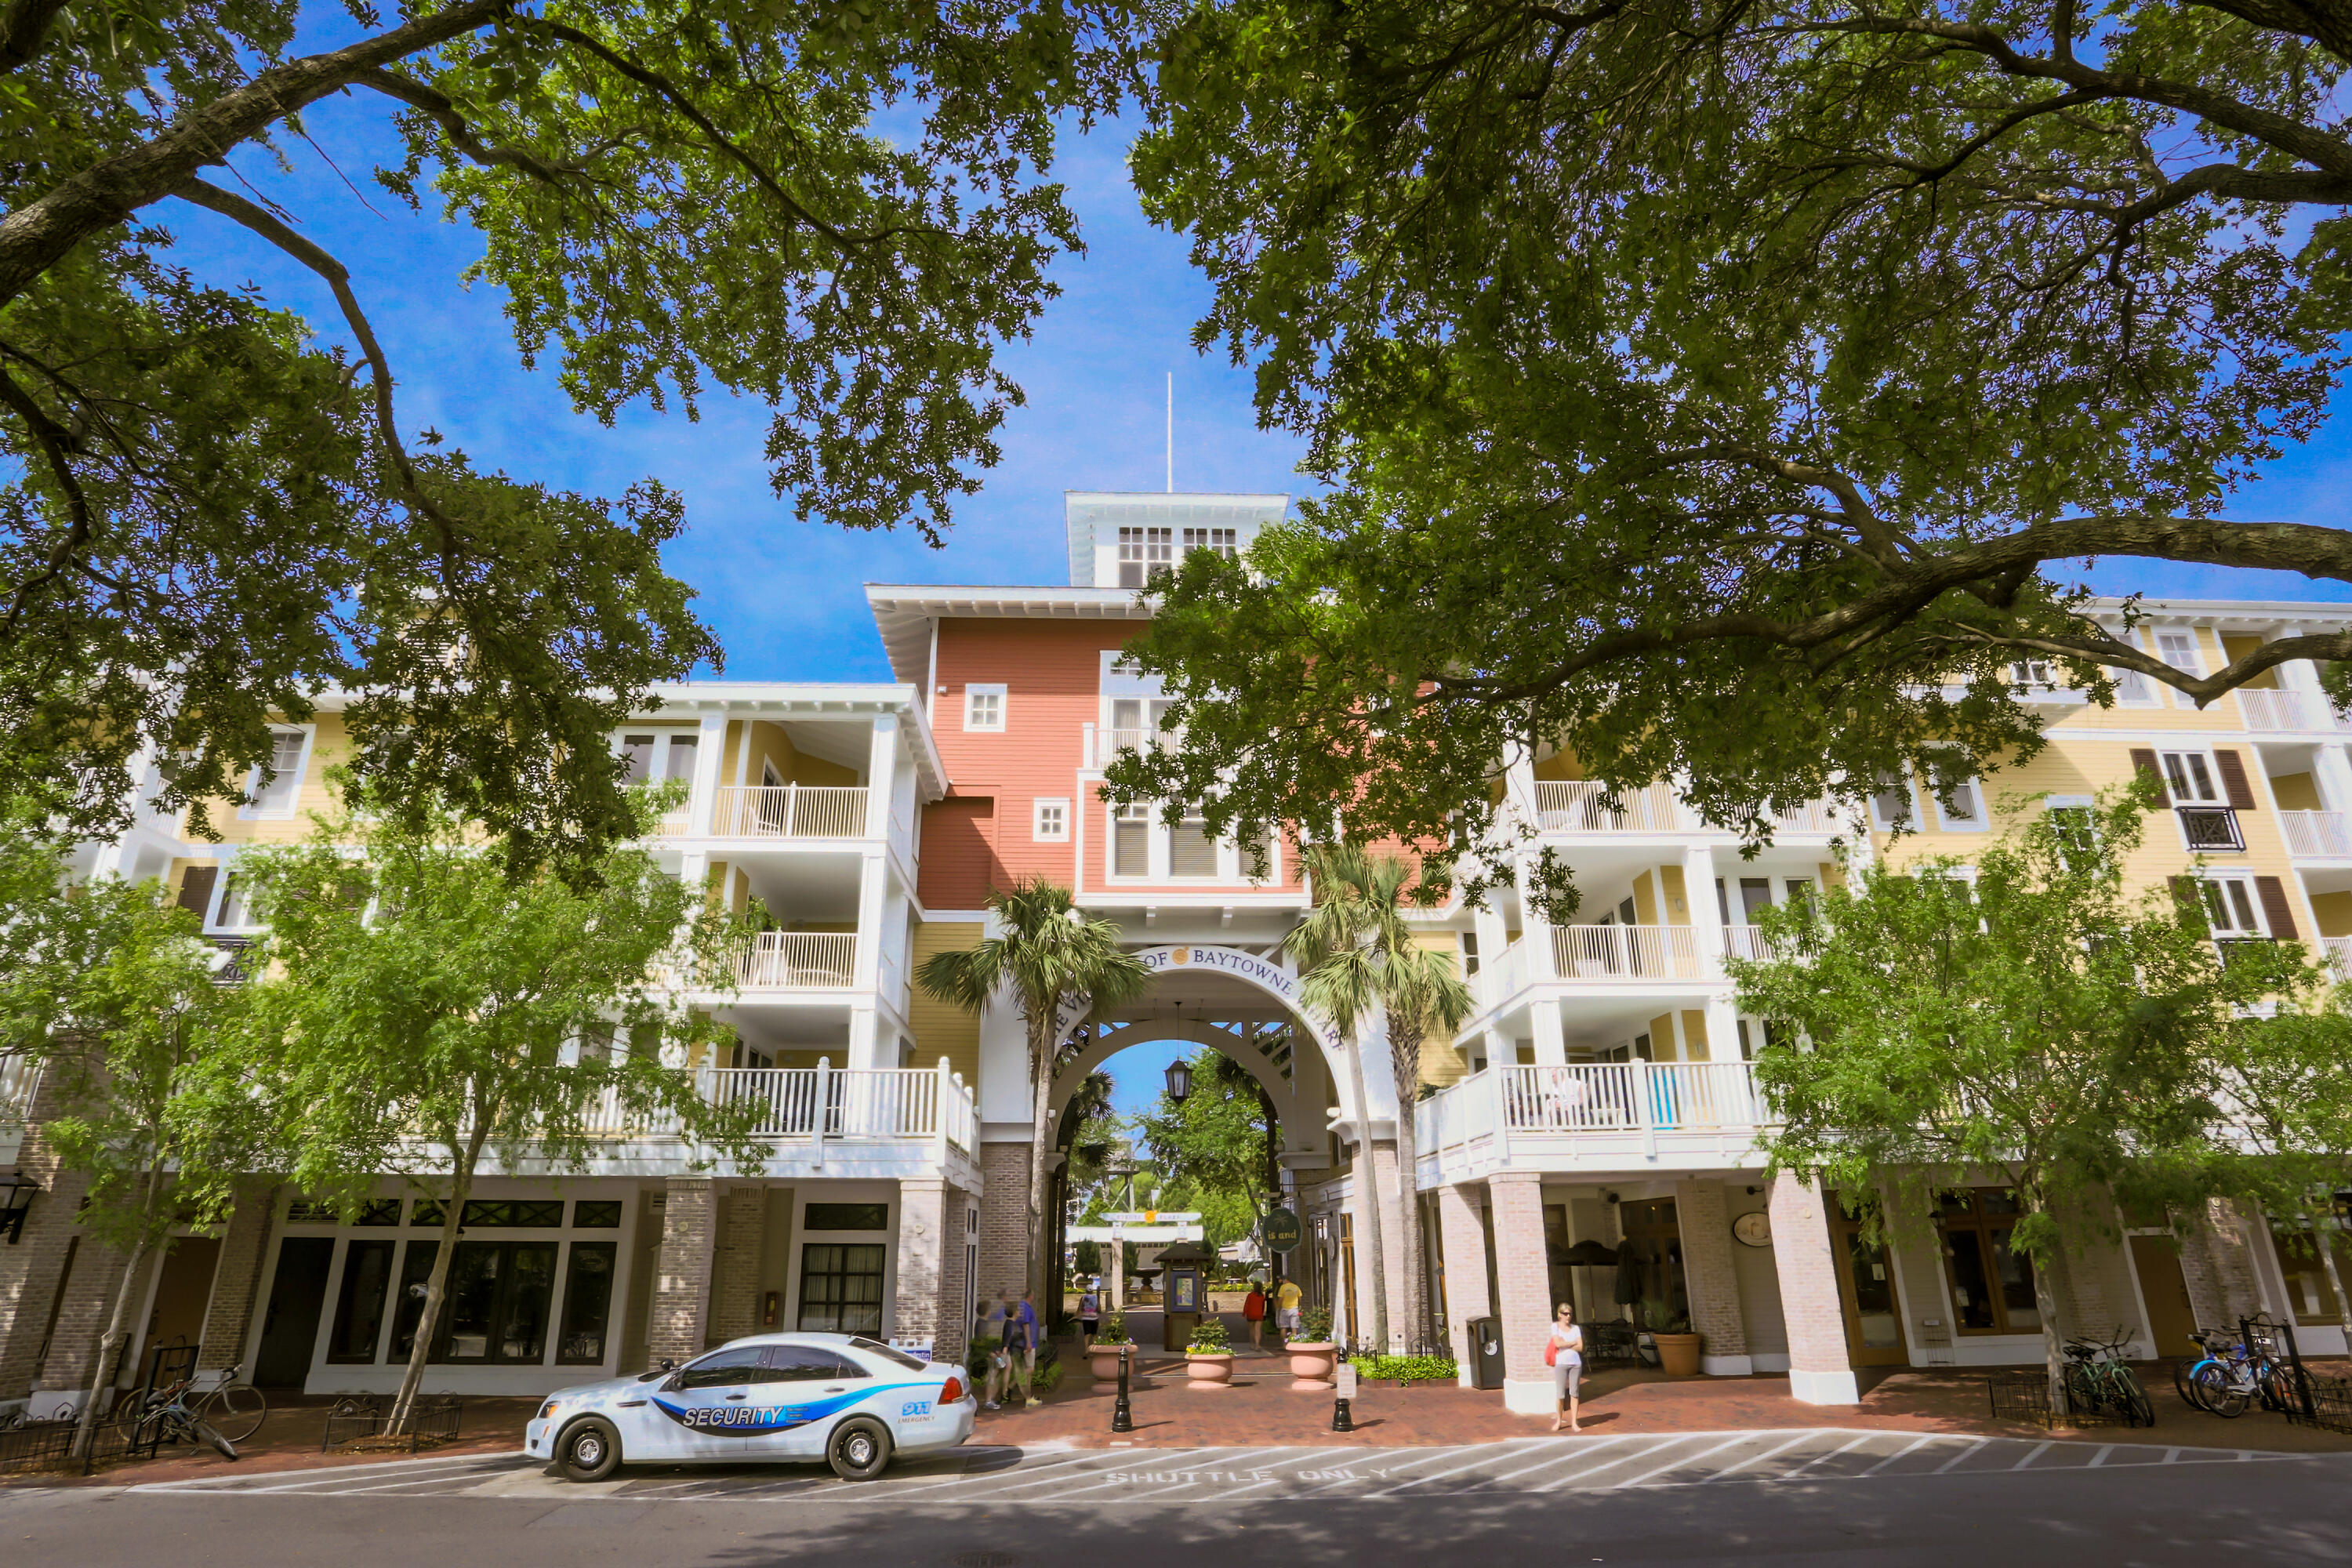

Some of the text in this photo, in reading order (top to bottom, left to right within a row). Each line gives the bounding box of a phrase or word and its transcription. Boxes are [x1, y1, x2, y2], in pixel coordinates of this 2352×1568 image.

[1144, 952, 1167, 968] OF
[1193, 949, 1294, 995] BAYTOWNE
[1267, 1229, 1298, 1240] isand
[683, 1406, 784, 1427] SECURITY
[902, 1400, 932, 1417] 911
[897, 1416, 935, 1425] EMERGENCY
[1105, 1468, 1387, 1483] SHUTTLE ONLY
